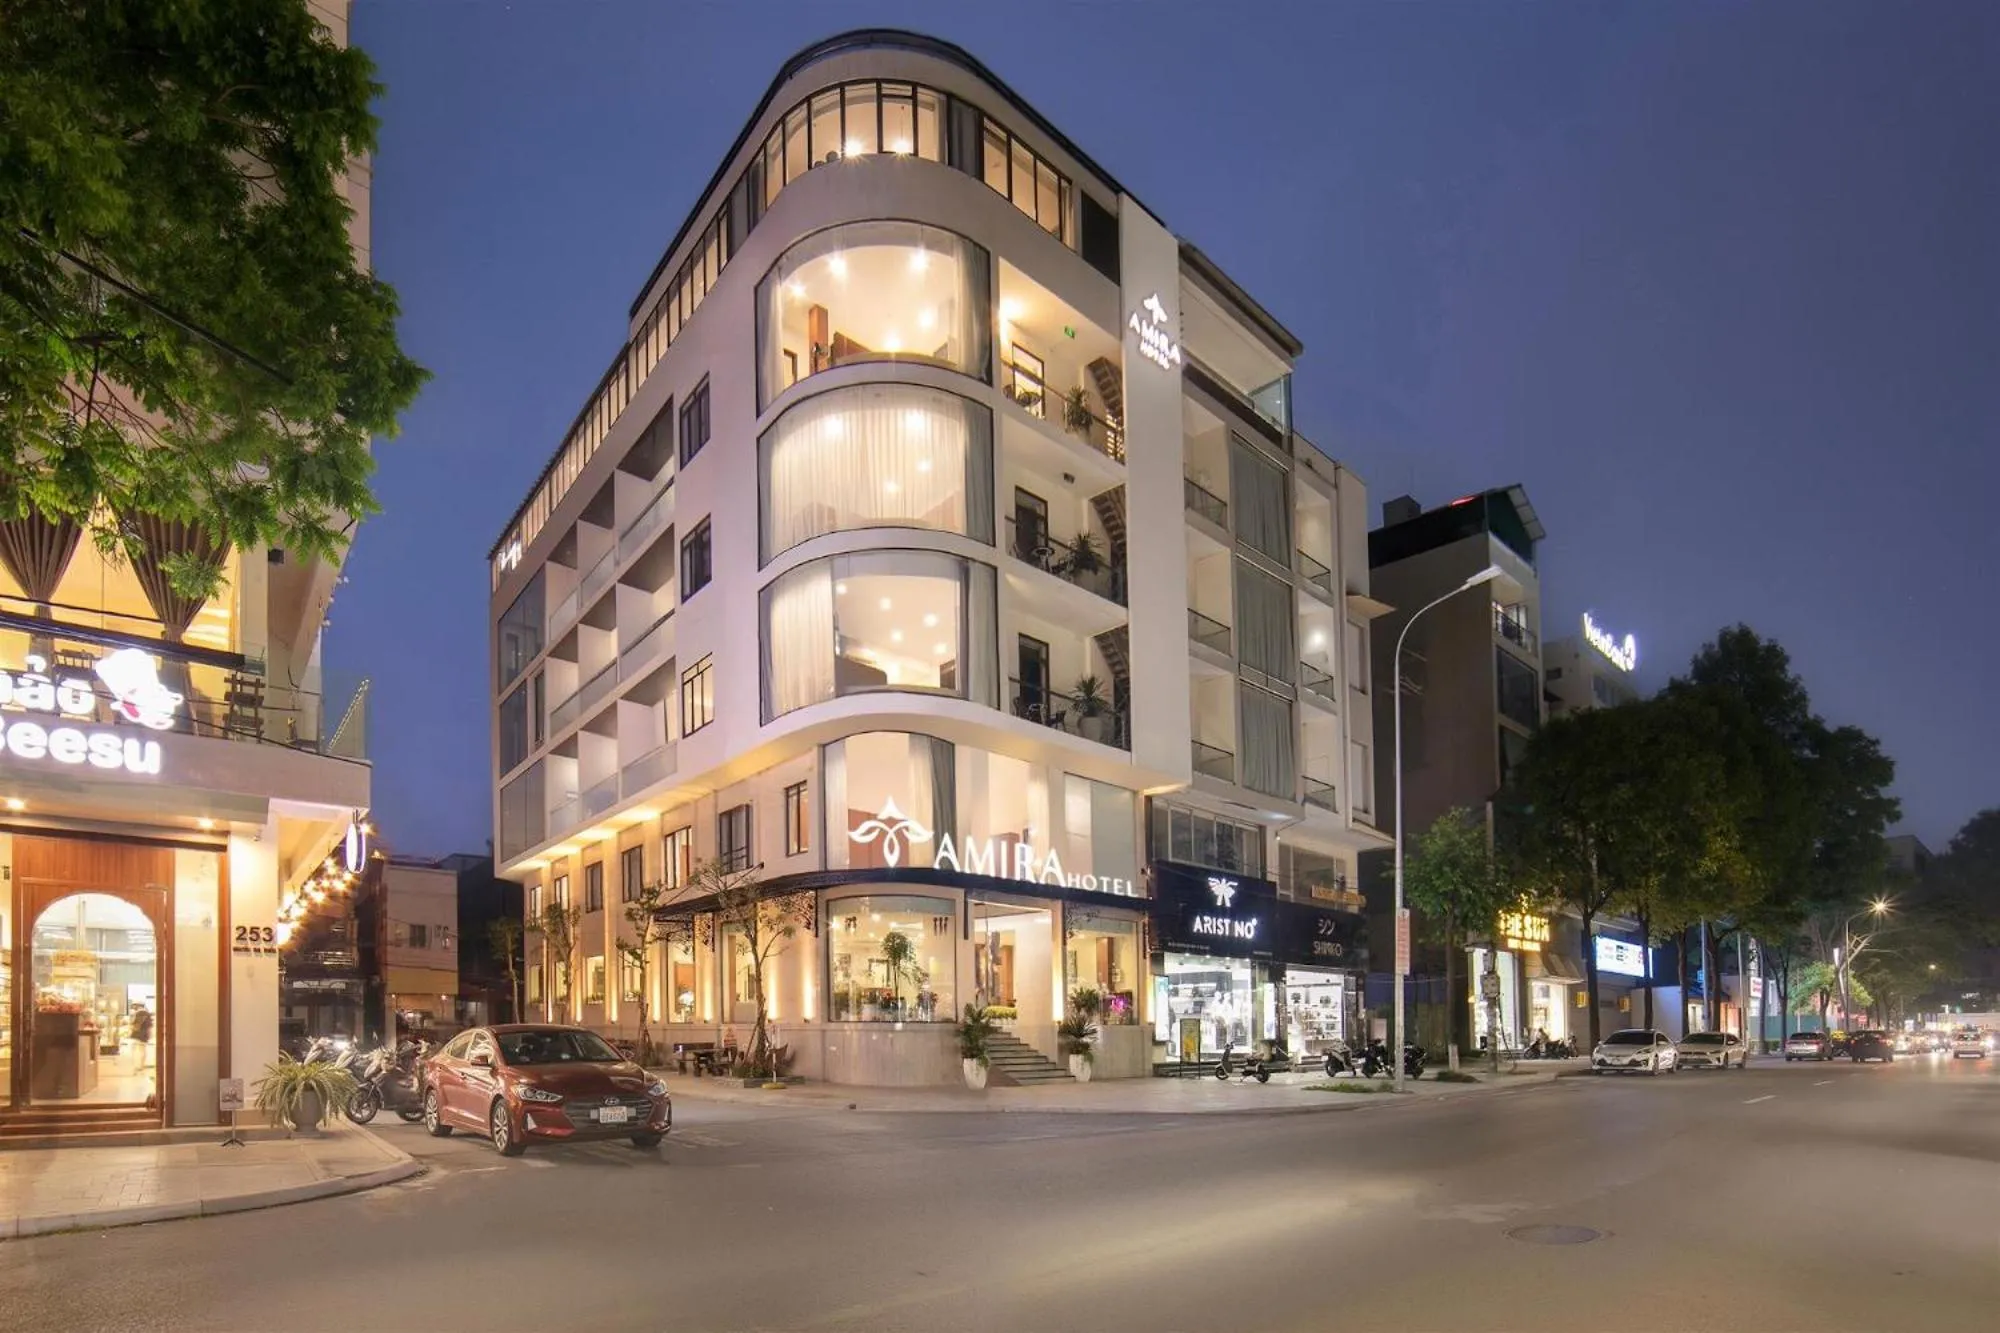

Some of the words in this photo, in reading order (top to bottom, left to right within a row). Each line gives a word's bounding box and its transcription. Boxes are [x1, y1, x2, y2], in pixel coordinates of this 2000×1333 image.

[1129, 312, 1181, 365] AMIRA
[0, 715, 161, 774] eesu
[933, 832, 1067, 888] AMIRA
[1067, 872, 1139, 898] HOTEL
[235, 925, 273, 942] 253
